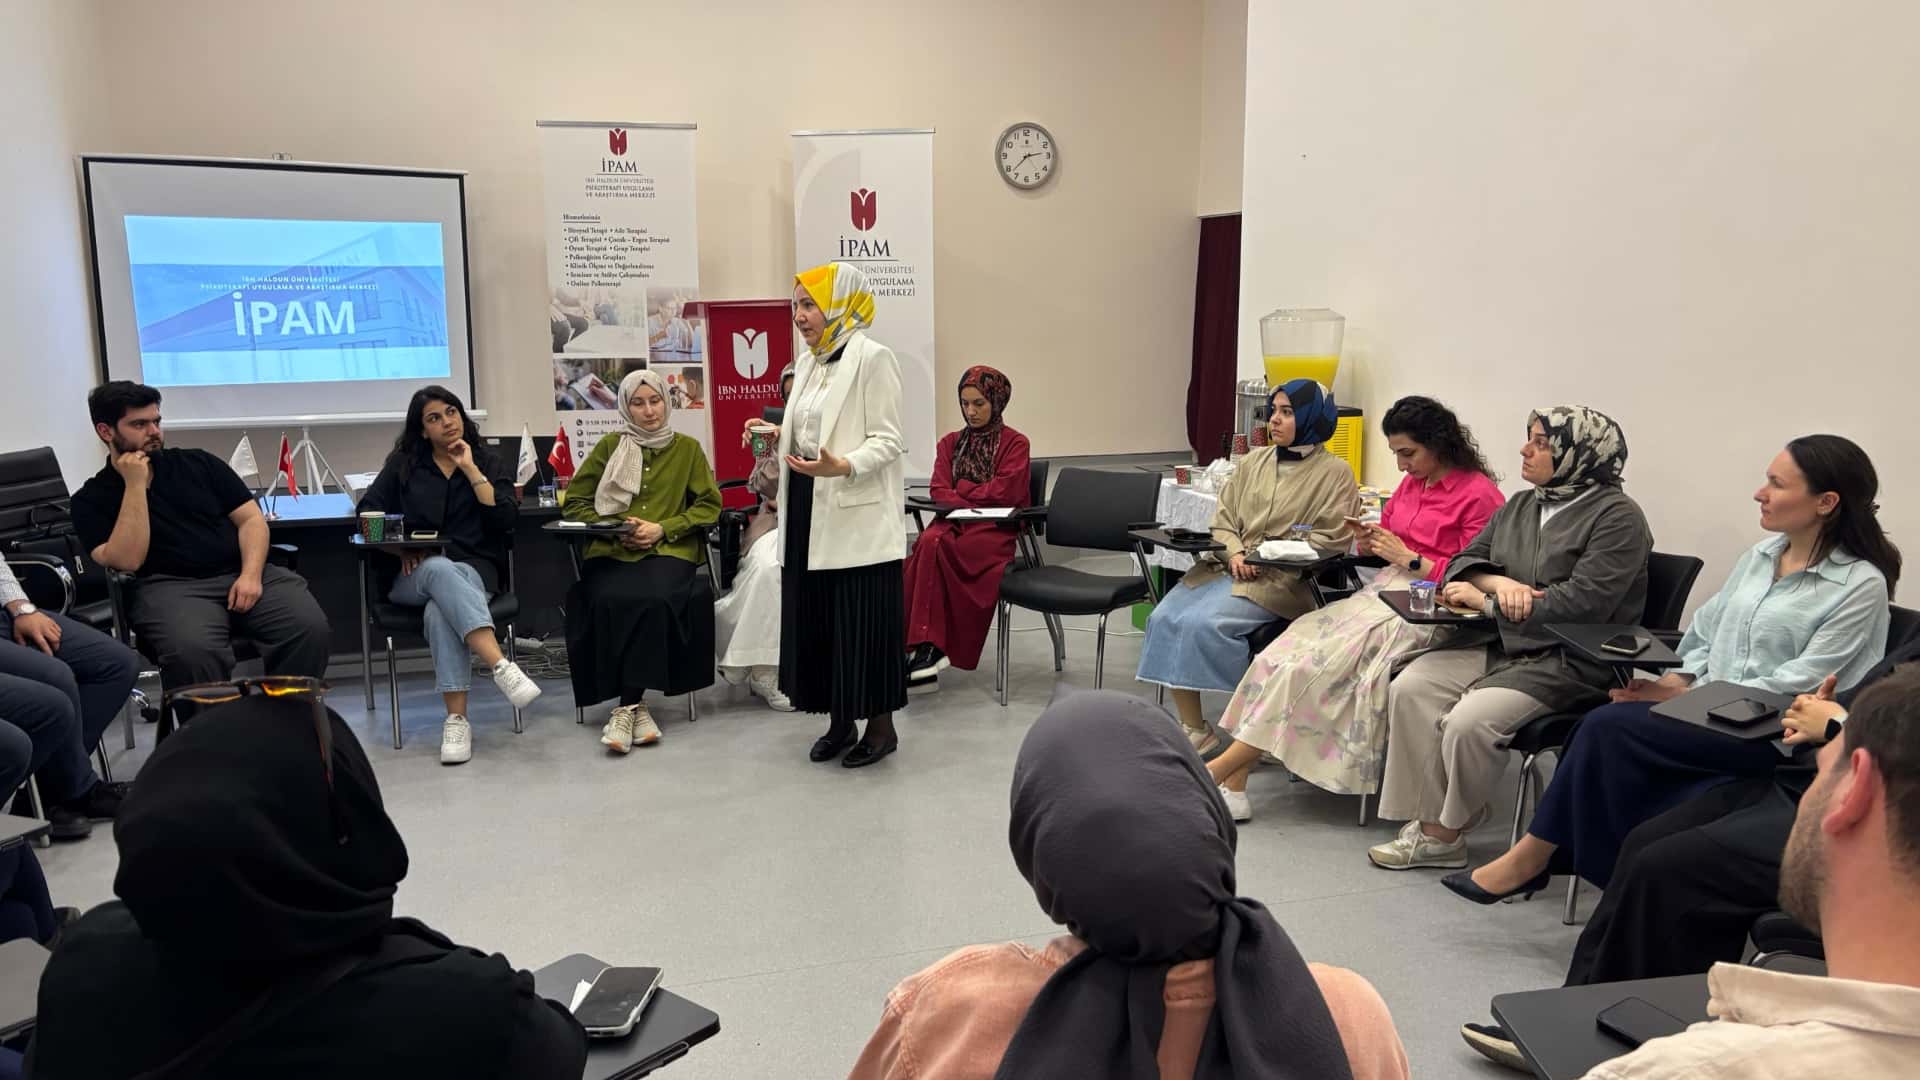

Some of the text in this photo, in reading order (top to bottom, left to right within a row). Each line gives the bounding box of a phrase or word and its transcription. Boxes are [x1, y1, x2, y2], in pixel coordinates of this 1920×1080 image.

[602, 157, 637, 173] İPAM
[840, 235, 891, 257] İPAM
[865, 264, 915, 274] ÜNİVERSİTESİ
[869, 277, 914, 286] UYGULAMA
[878, 287, 916, 297] MERKEZİ
[232, 291, 356, 337] İPAM
[718, 383, 781, 395] İBN HALDU
